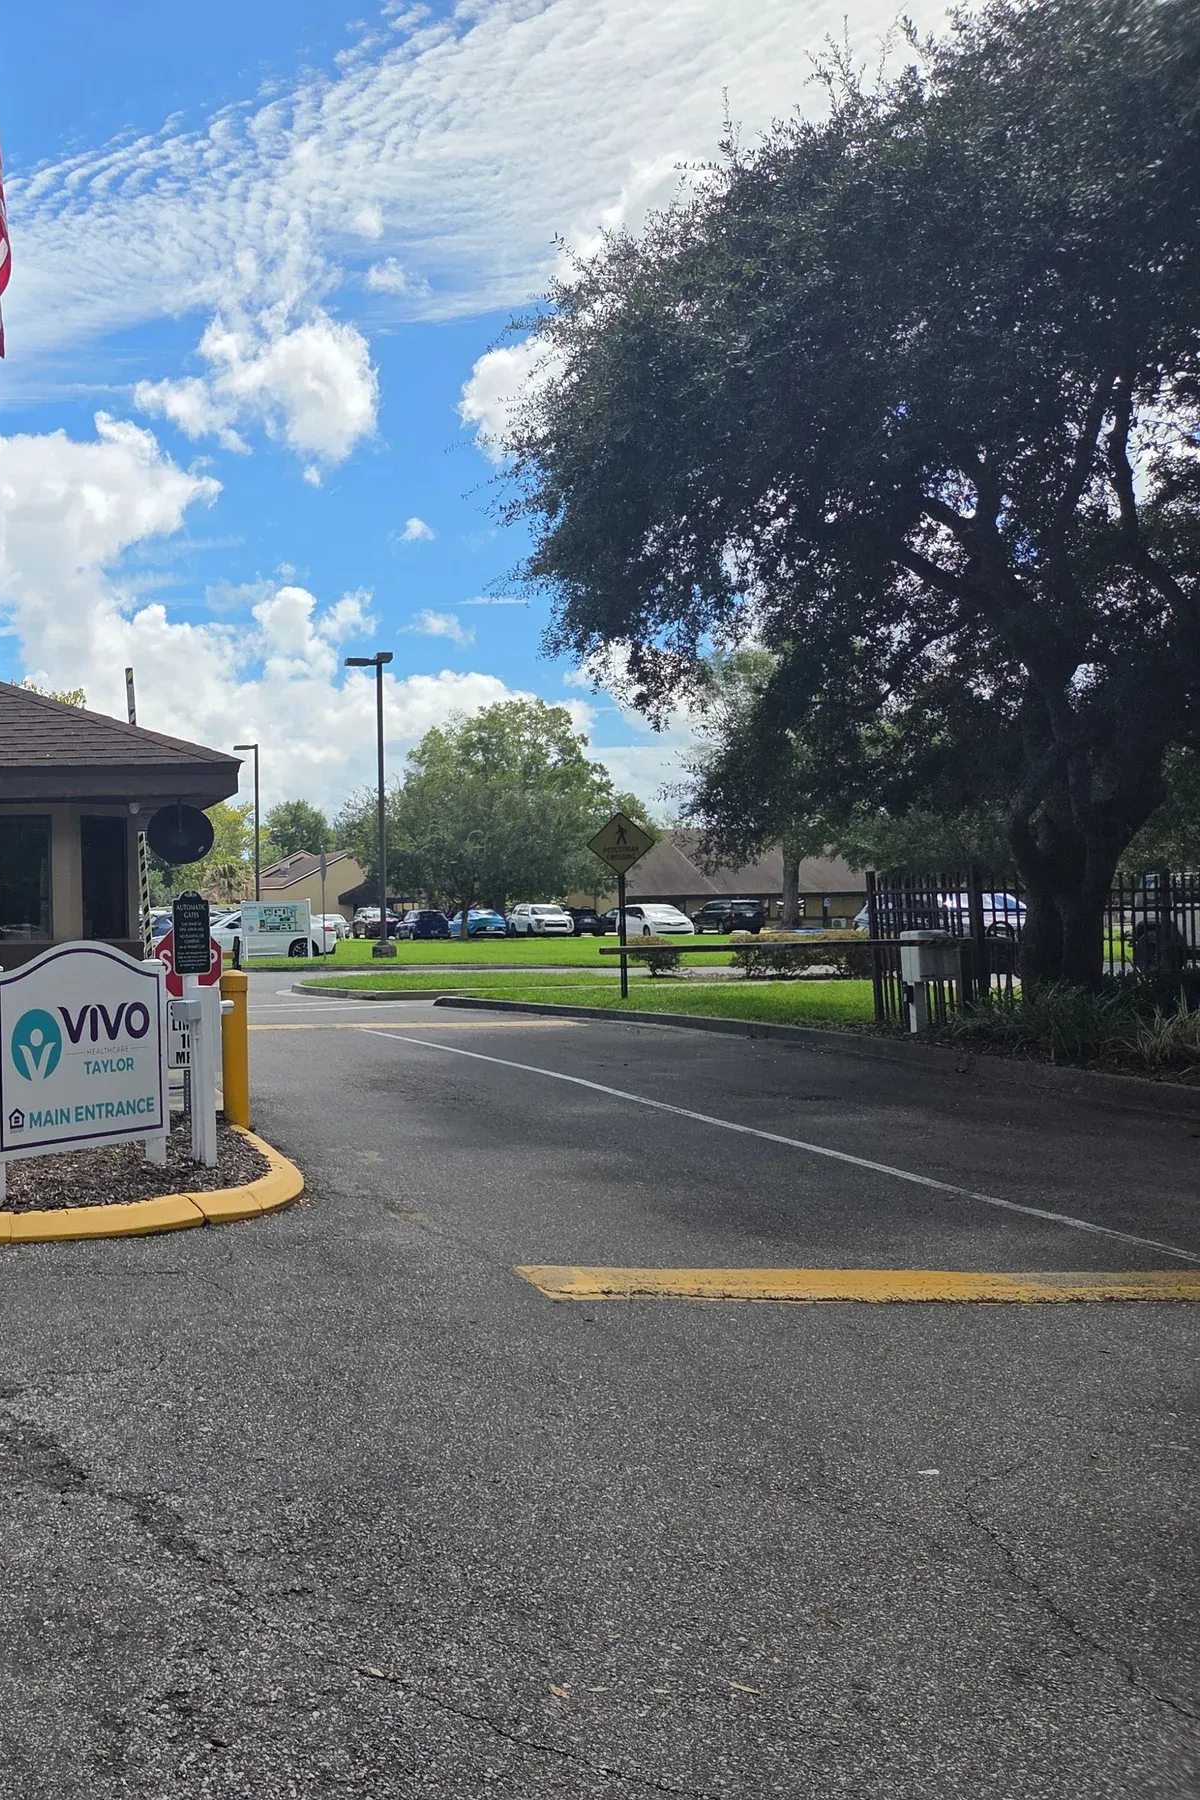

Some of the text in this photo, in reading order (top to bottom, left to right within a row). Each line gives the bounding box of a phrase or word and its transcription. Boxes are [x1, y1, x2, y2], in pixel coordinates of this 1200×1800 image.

[176, 903, 206, 911] AUTOMATIC
[183, 911, 200, 919] GATES
[57, 1001, 150, 1044] VIVO
[86, 1046, 129, 1055] HEALTHCARE
[84, 1057, 134, 1075] TAYLOR
[29, 1096, 155, 1129] MAIN ENTRANCE
